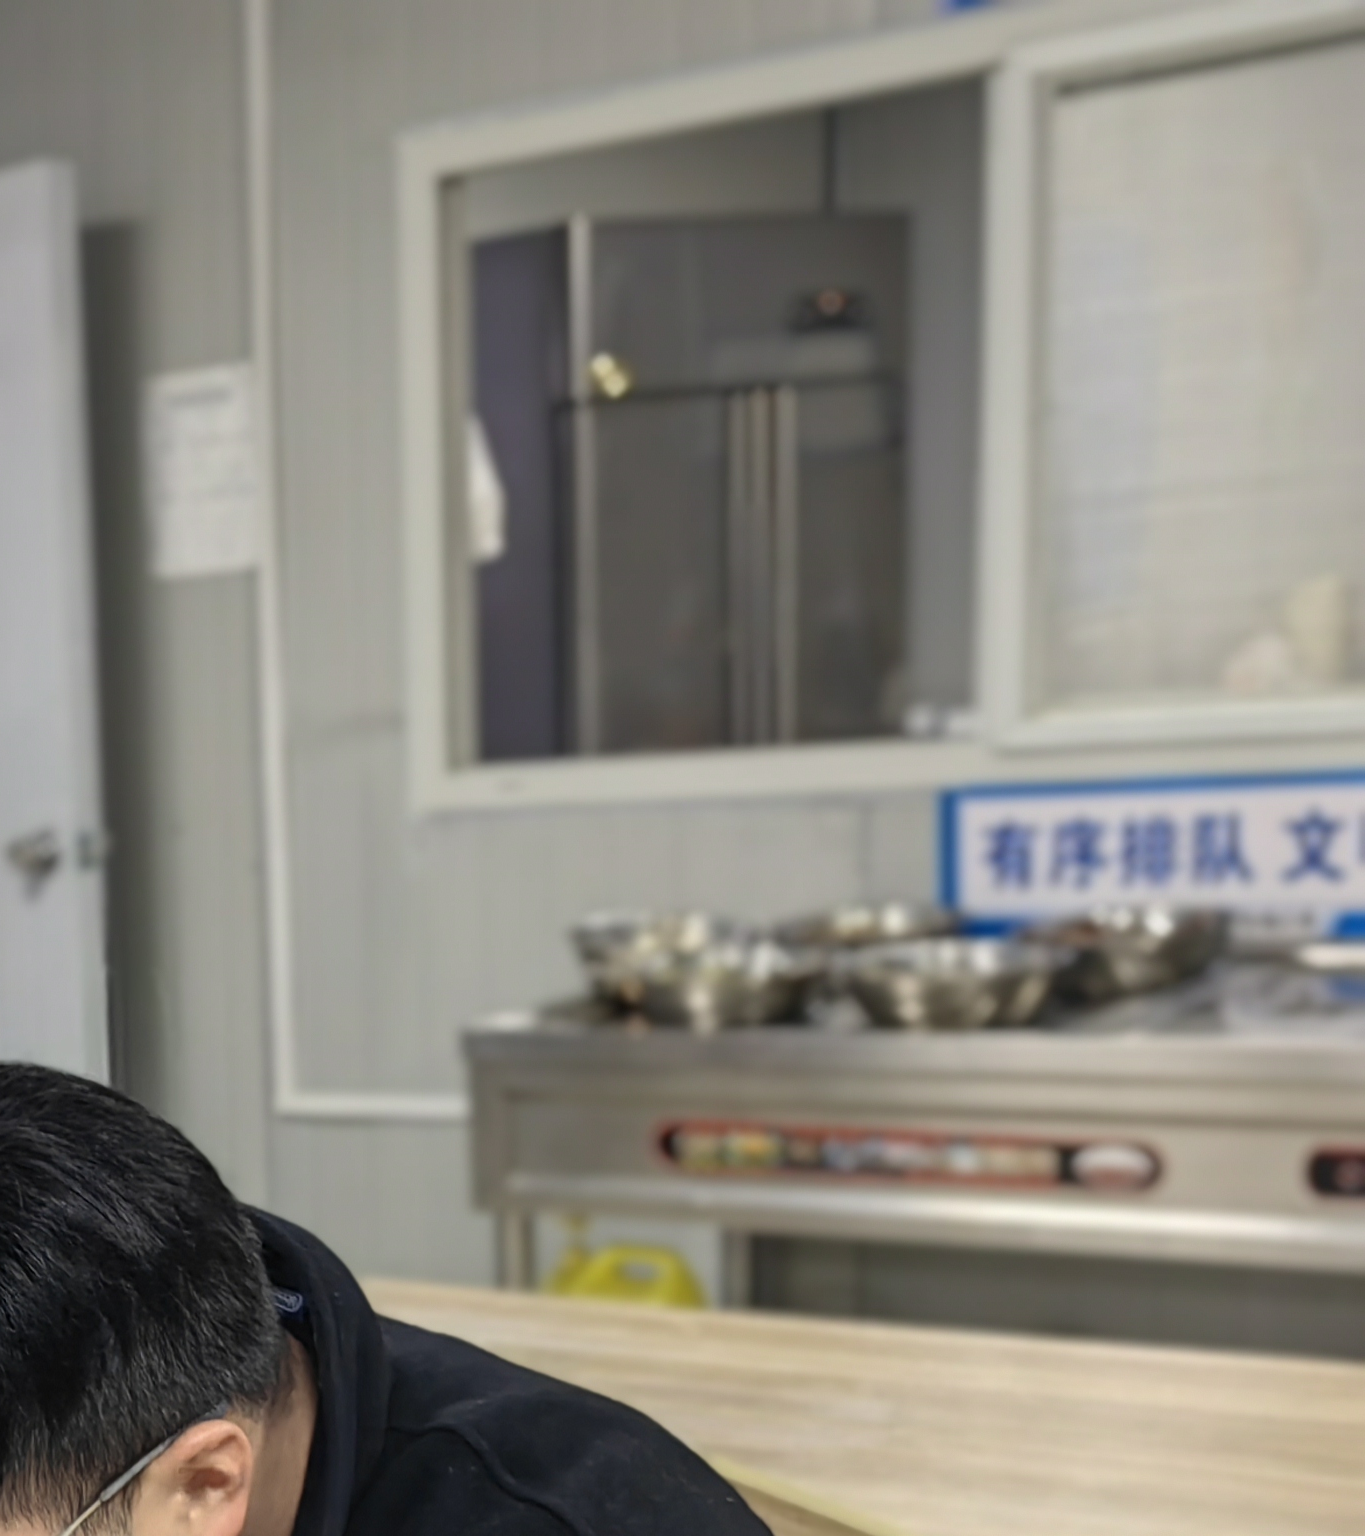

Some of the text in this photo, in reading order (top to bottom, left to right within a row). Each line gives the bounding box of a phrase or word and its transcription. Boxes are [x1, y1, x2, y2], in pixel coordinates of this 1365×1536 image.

[982, 806, 1365, 891] 有序排队 文
